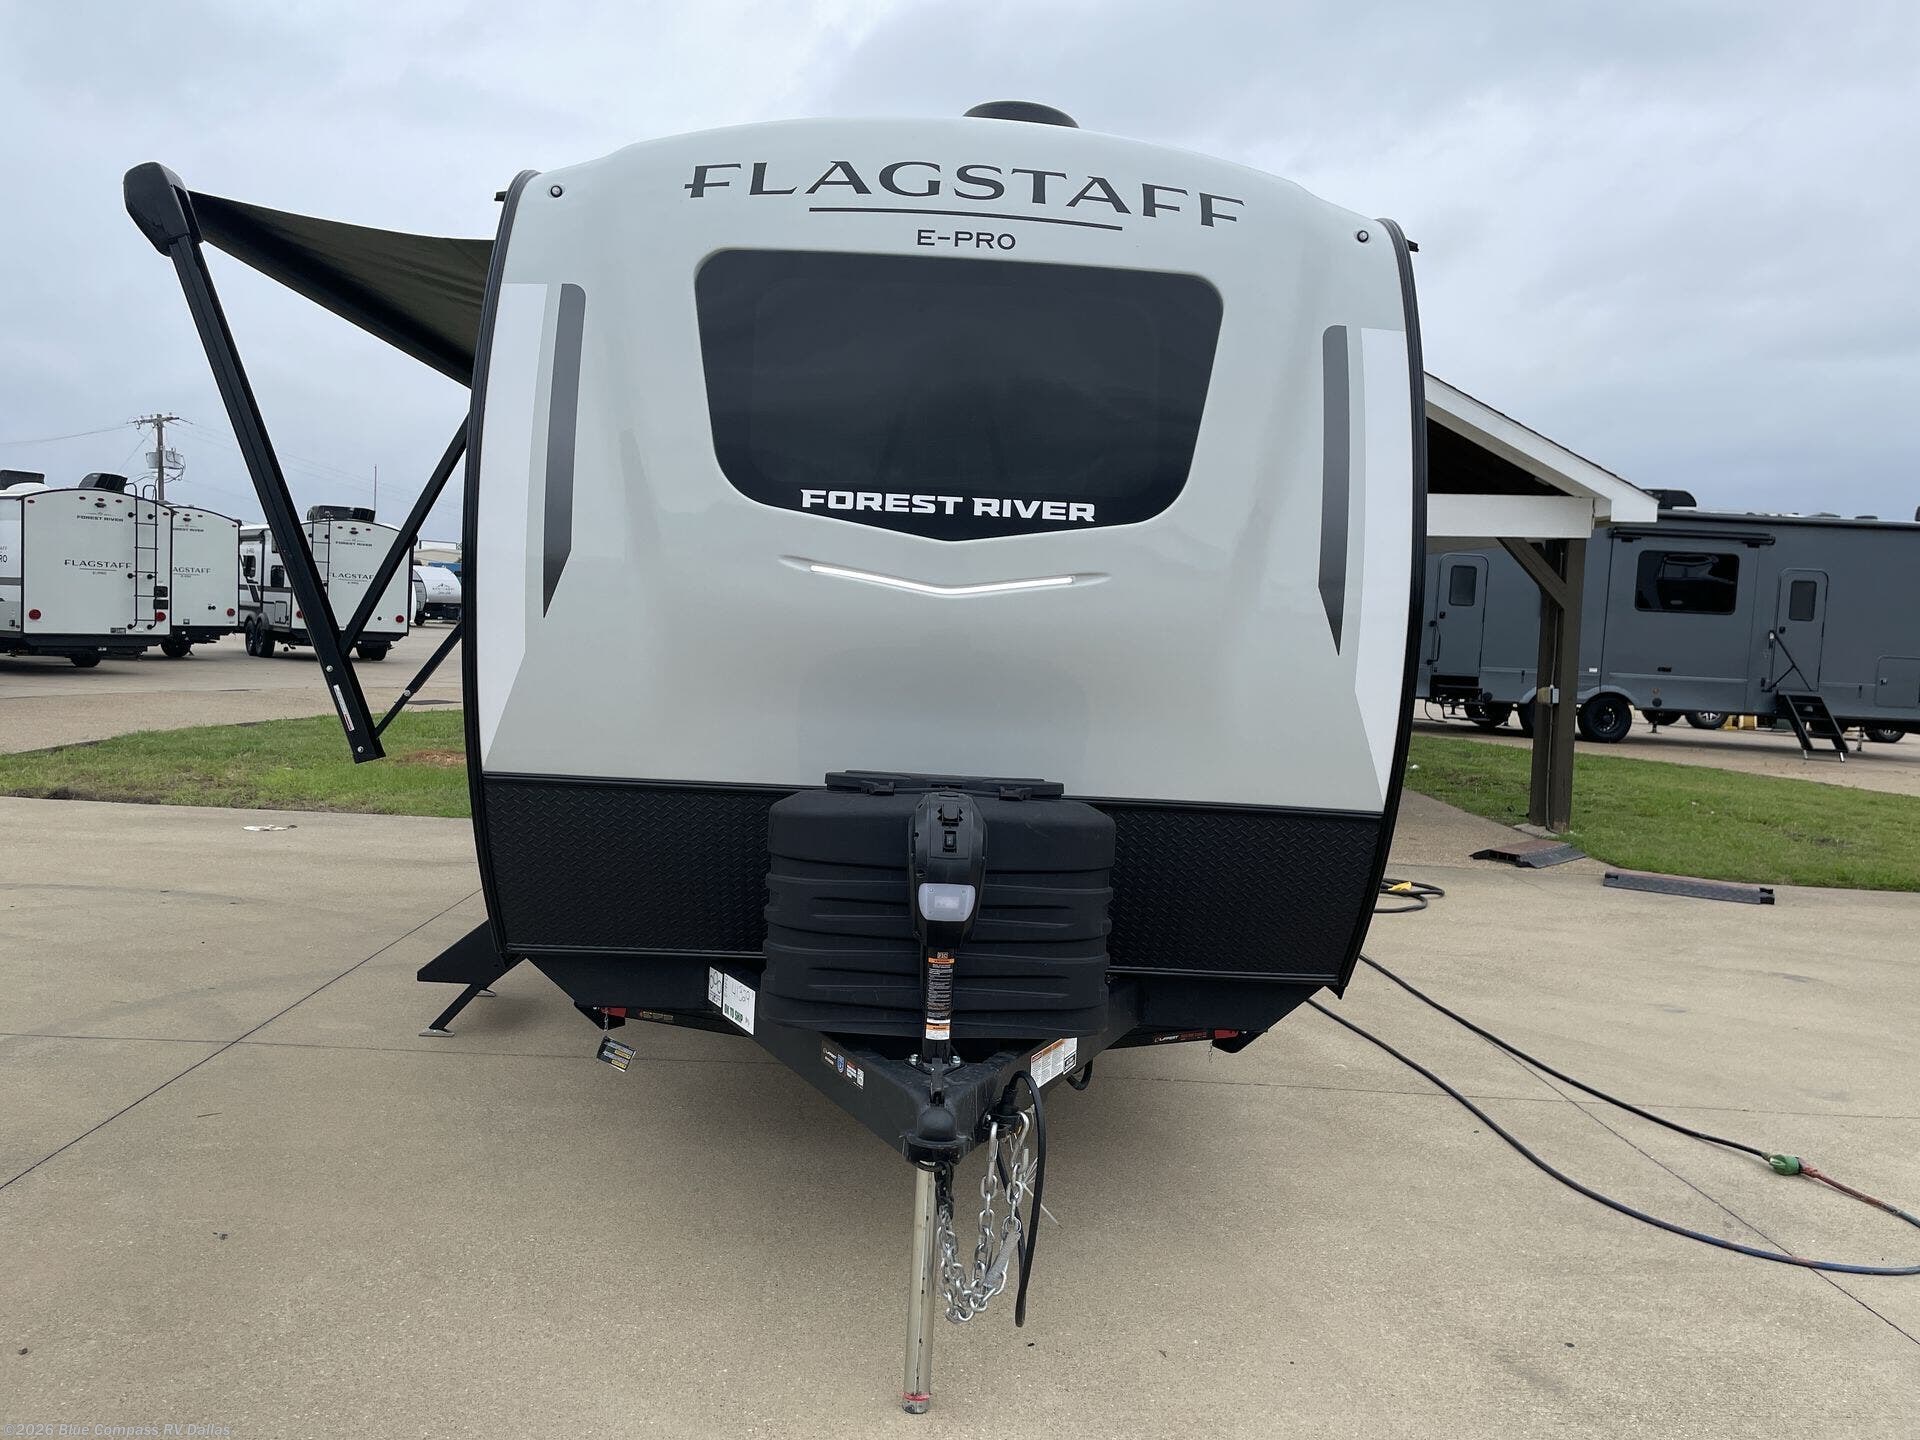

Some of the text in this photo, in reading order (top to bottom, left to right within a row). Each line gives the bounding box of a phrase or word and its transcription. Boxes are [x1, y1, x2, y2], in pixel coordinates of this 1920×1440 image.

[683, 160, 1245, 228] FLAGSTAFF
[916, 229, 1017, 251] E-PRO
[800, 489, 1096, 522] FOREST RIVER
[64, 559, 133, 569] FLAGSTAFF
[173, 566, 212, 574] AGSTAFF
